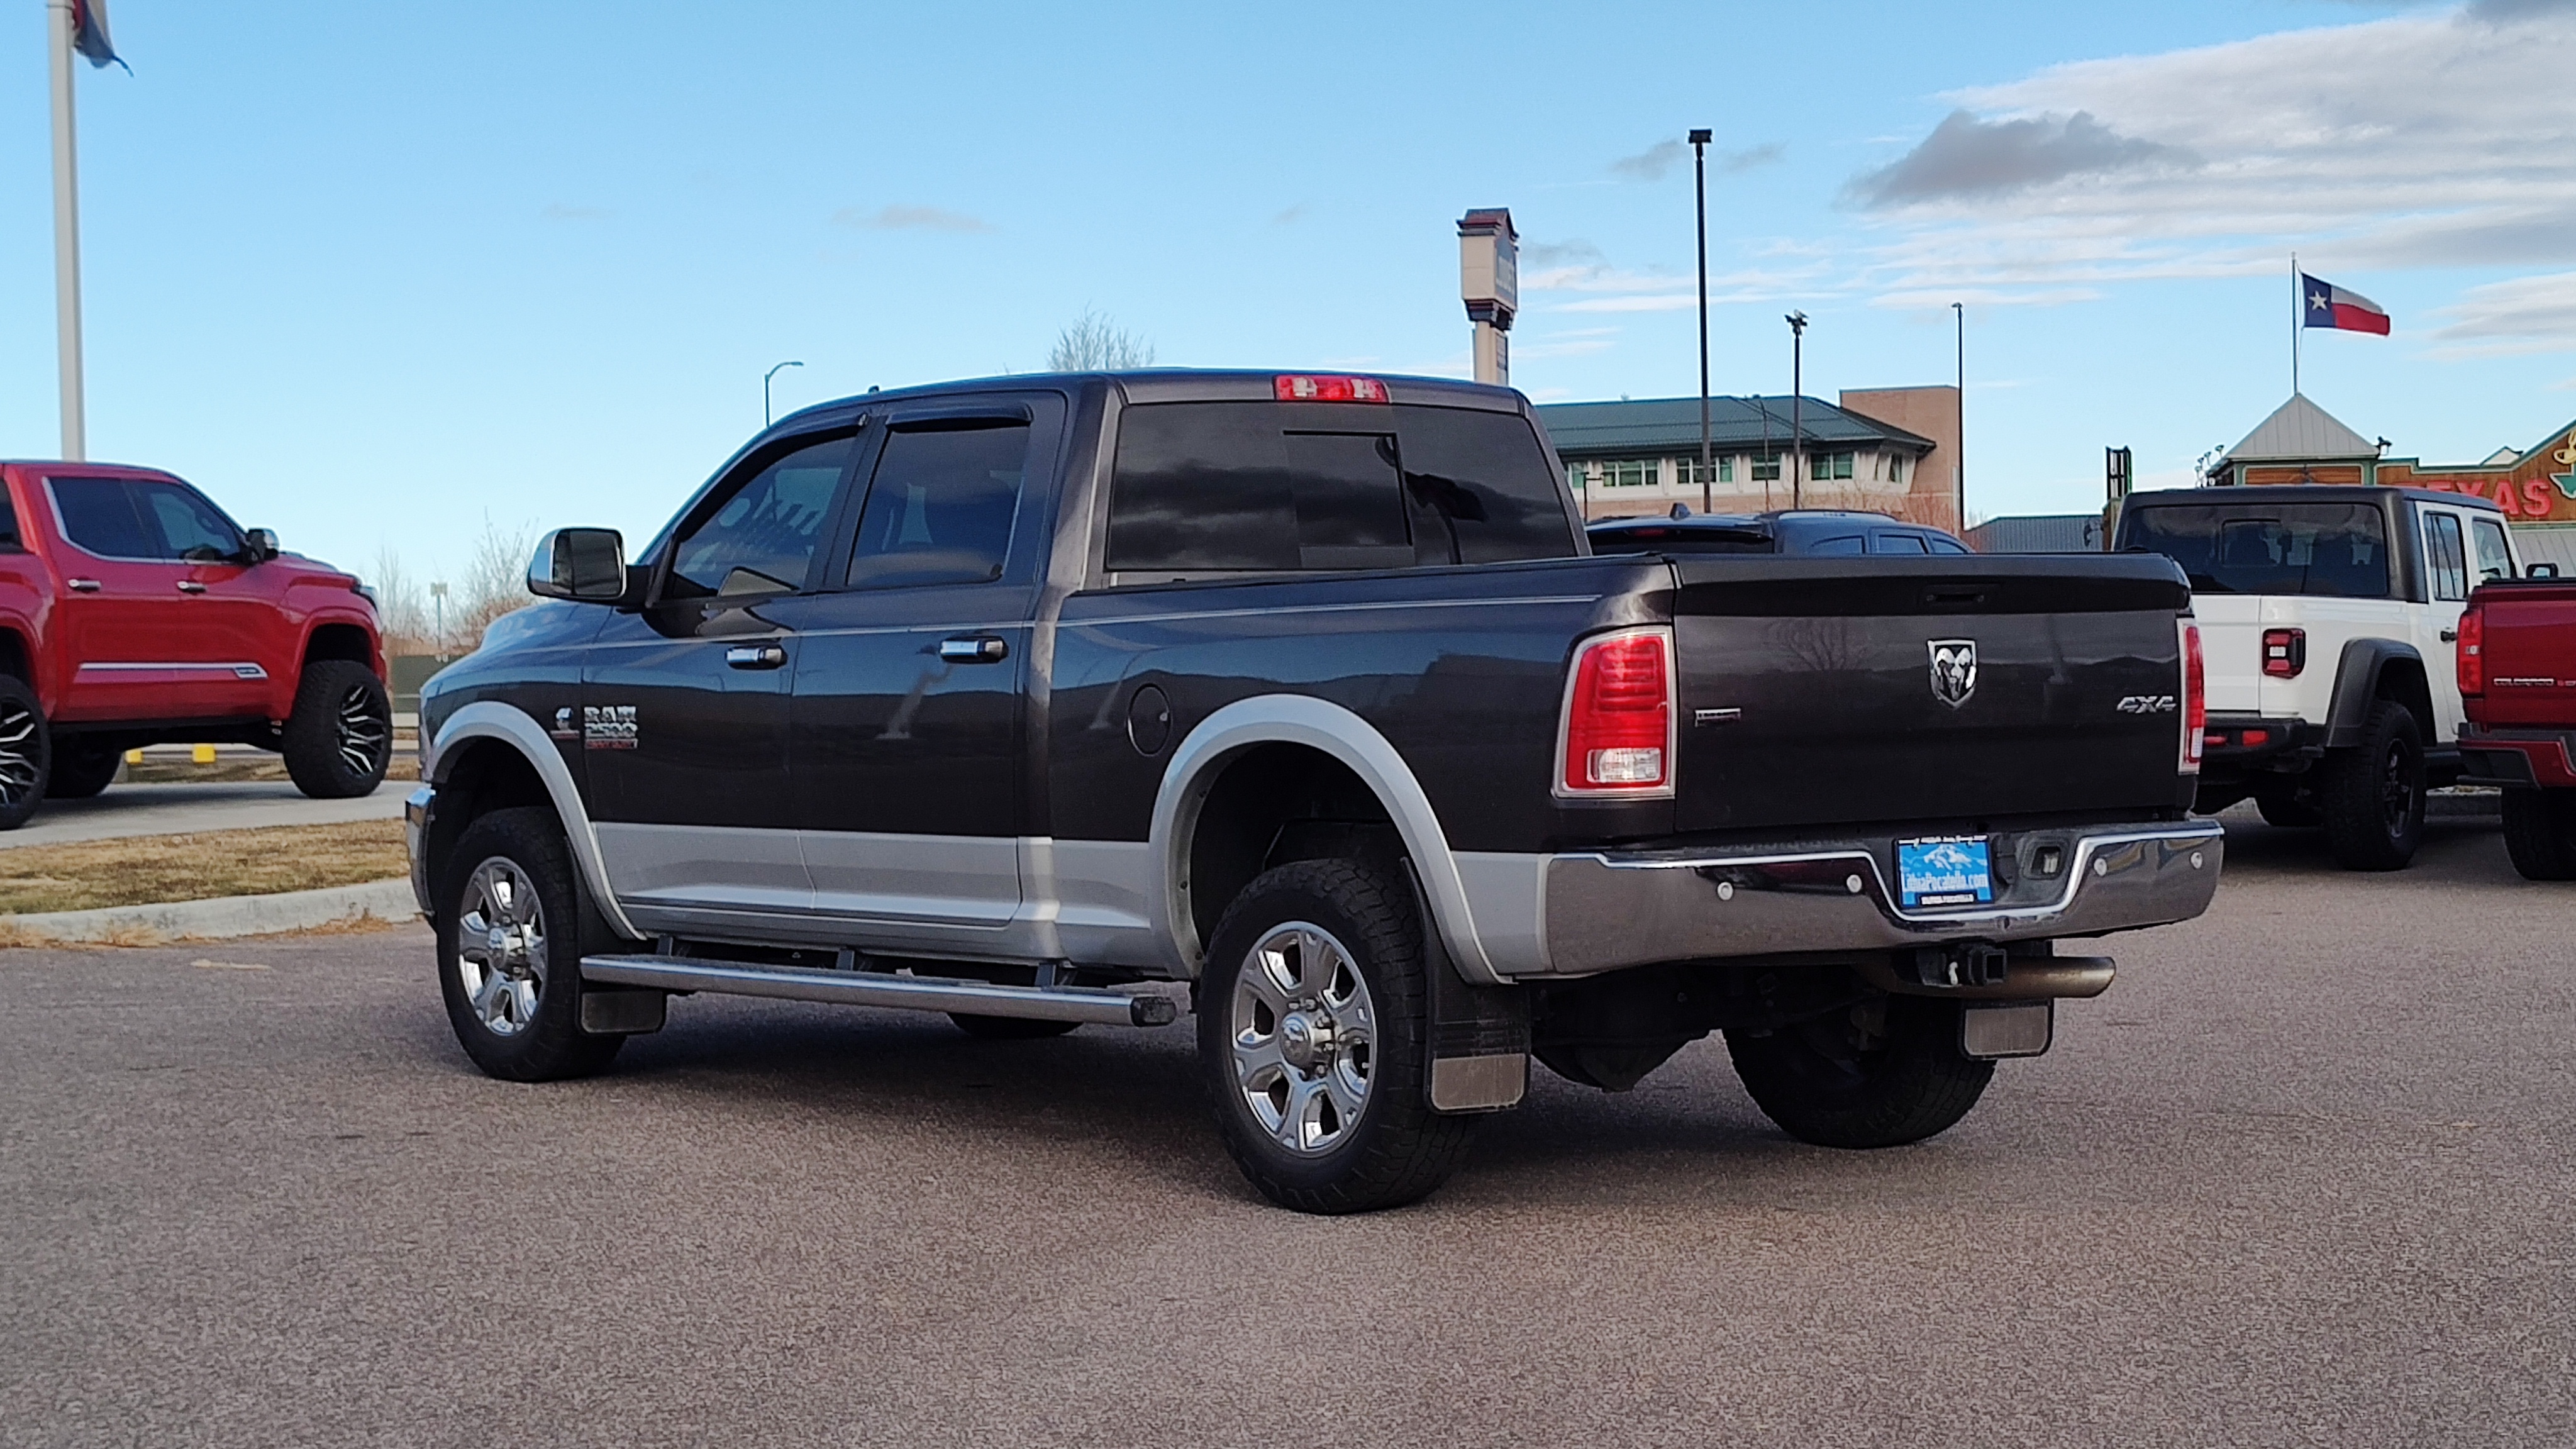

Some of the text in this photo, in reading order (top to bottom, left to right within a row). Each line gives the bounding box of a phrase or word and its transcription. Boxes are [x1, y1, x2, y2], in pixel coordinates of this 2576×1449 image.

[2392, 479, 2553, 517] XAS
[584, 706, 636, 722] RAM
[584, 723, 638, 737] 2500
